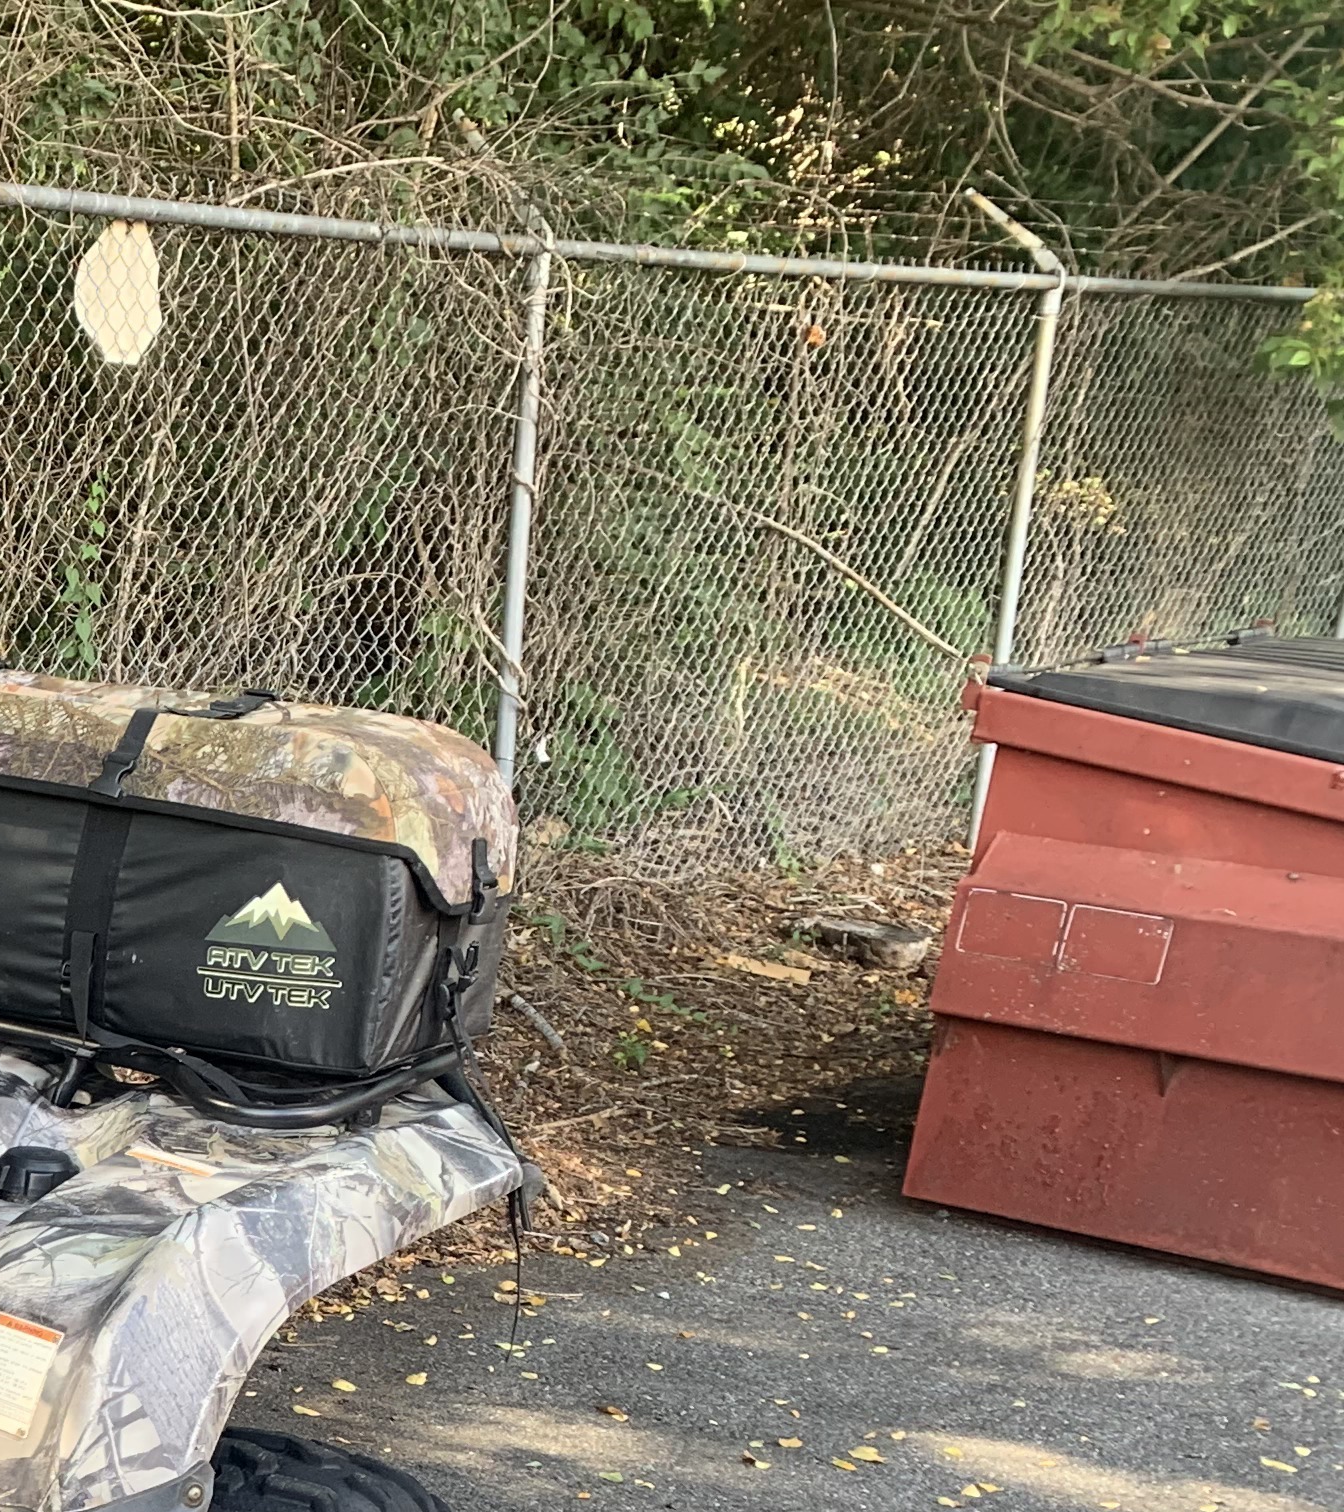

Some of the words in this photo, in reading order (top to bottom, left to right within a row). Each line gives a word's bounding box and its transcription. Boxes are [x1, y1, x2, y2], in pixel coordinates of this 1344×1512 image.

[207, 945, 268, 970] ATV
[271, 951, 335, 976] TEK
[204, 977, 264, 1003] UTV
[267, 984, 331, 1009] TEK
